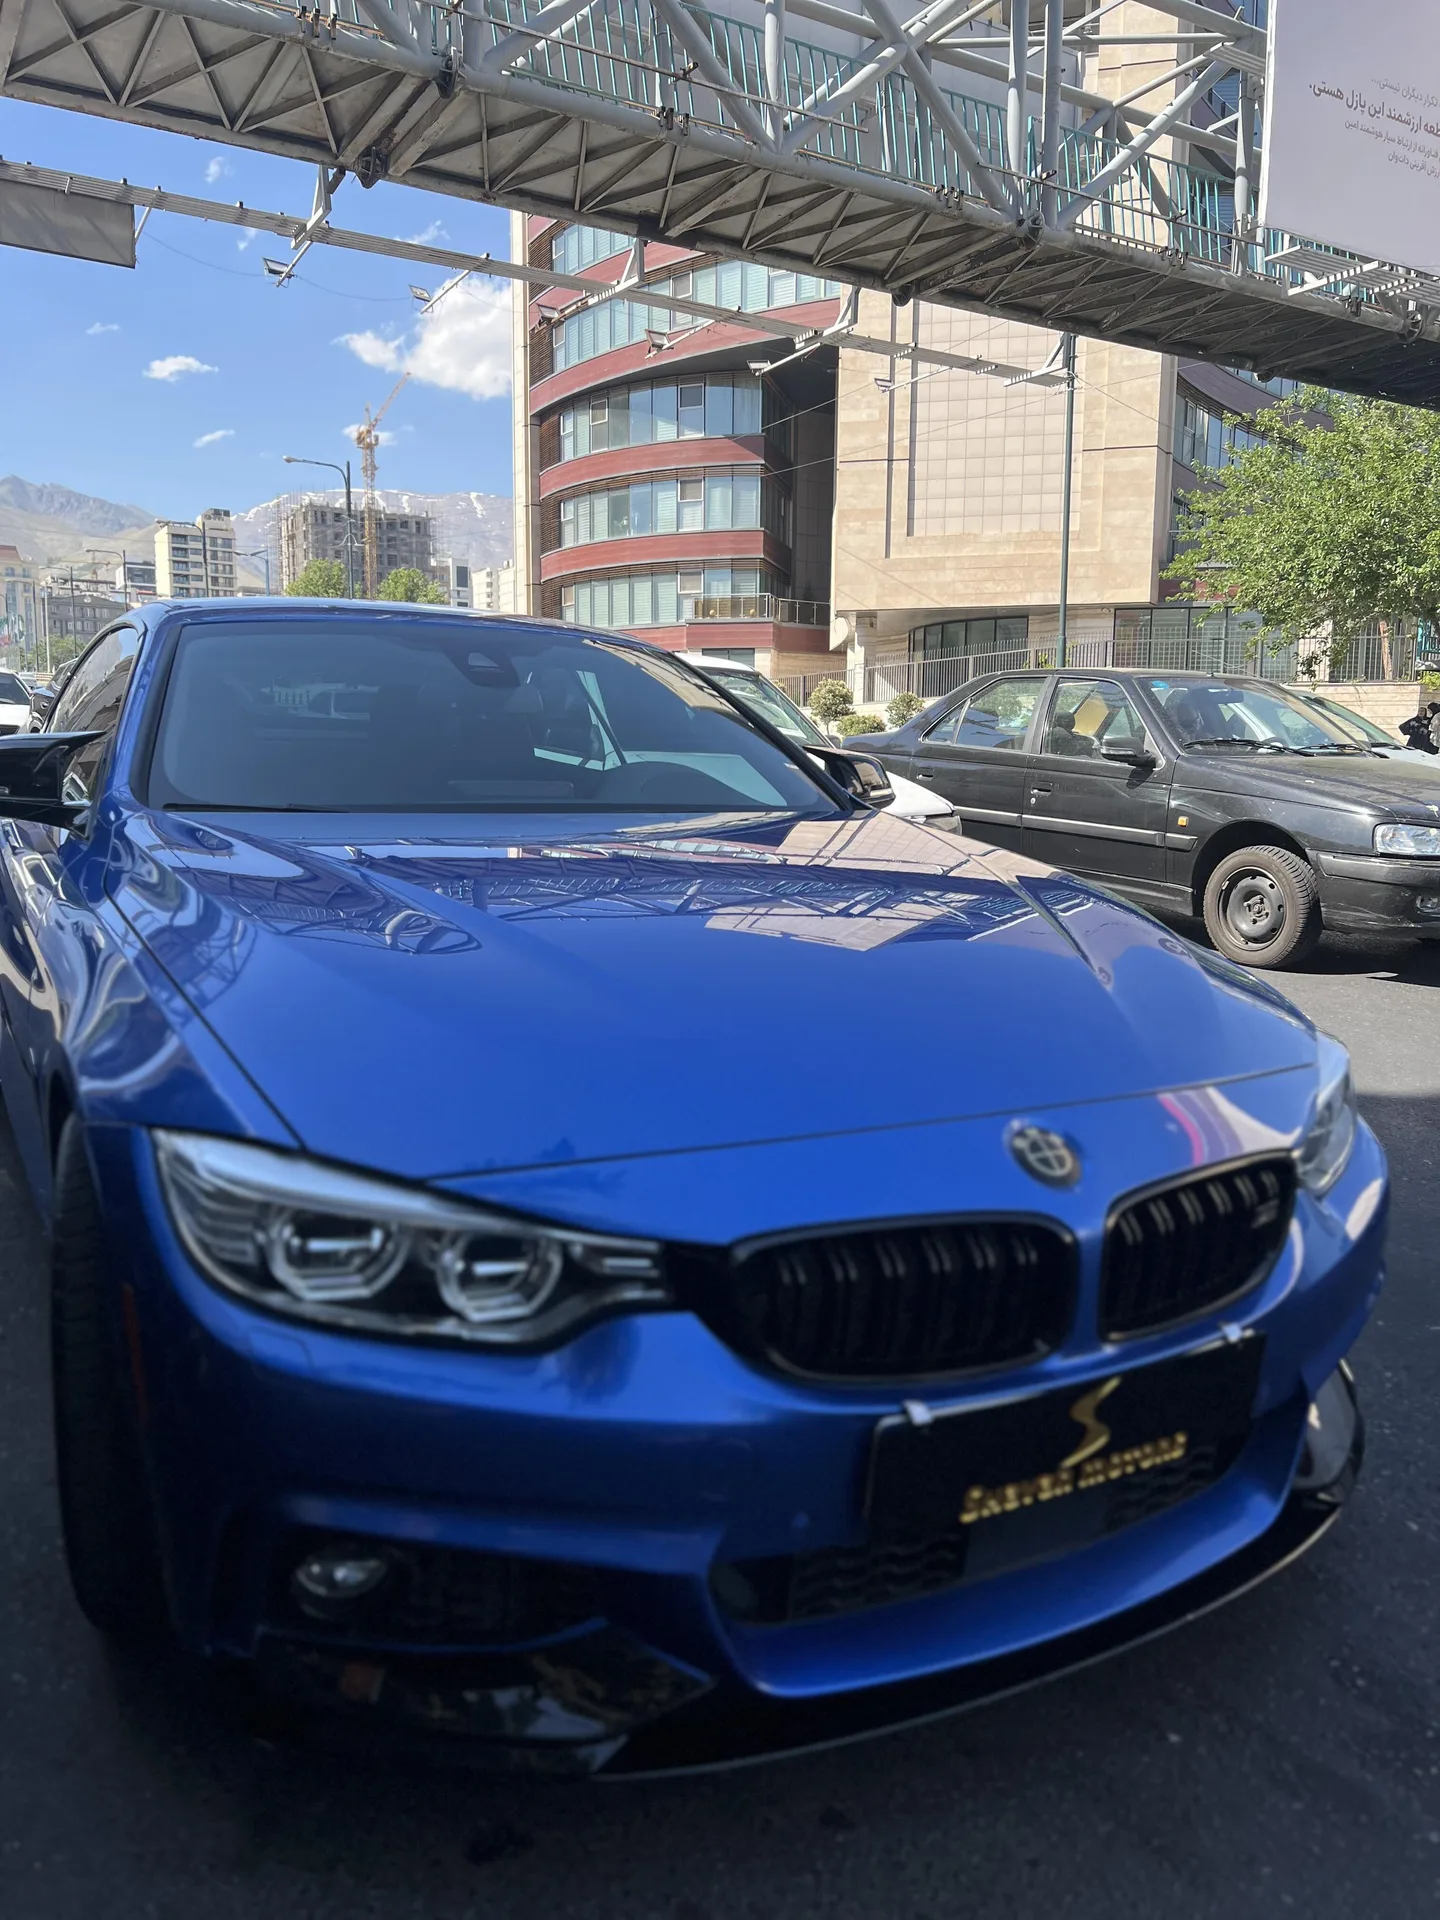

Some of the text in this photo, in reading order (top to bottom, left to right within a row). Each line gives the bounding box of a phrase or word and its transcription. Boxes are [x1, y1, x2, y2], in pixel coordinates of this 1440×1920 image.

[1345, 90, 1366, 114] پازل
[1368, 102, 1385, 119] این
[1386, 108, 1422, 133] ارزشمند
[1423, 121, 1440, 137] طعه
[1360, 124, 1383, 139] هوشمند
